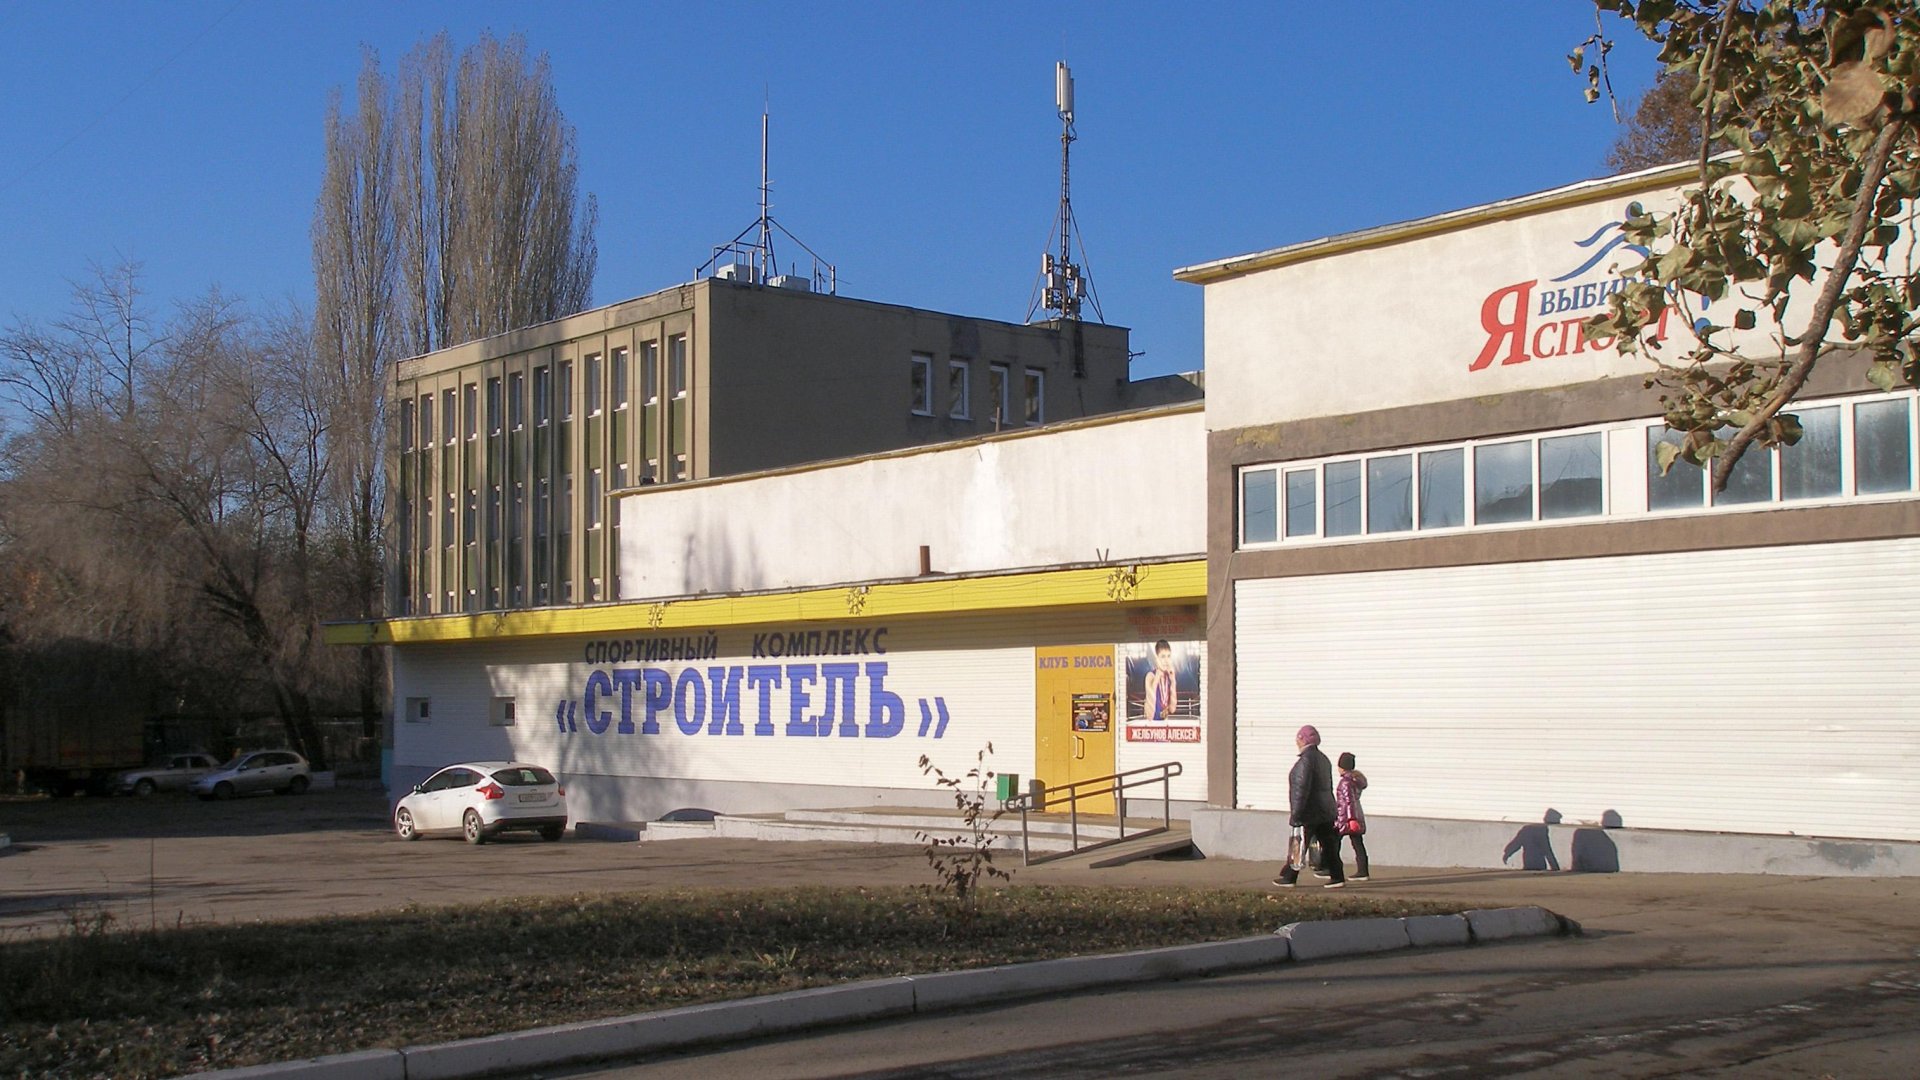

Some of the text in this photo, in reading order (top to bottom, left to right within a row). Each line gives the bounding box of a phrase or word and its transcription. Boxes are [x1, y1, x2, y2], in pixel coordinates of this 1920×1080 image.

[1469, 279, 1538, 372] Я
[585, 627, 888, 665] СПОРТИВНЫЙ КОМПЛЕКС
[1039, 655, 1112, 669] КЛУБ БОКСА
[1167, 727, 1198, 741] АЛЕКСЕЙ
